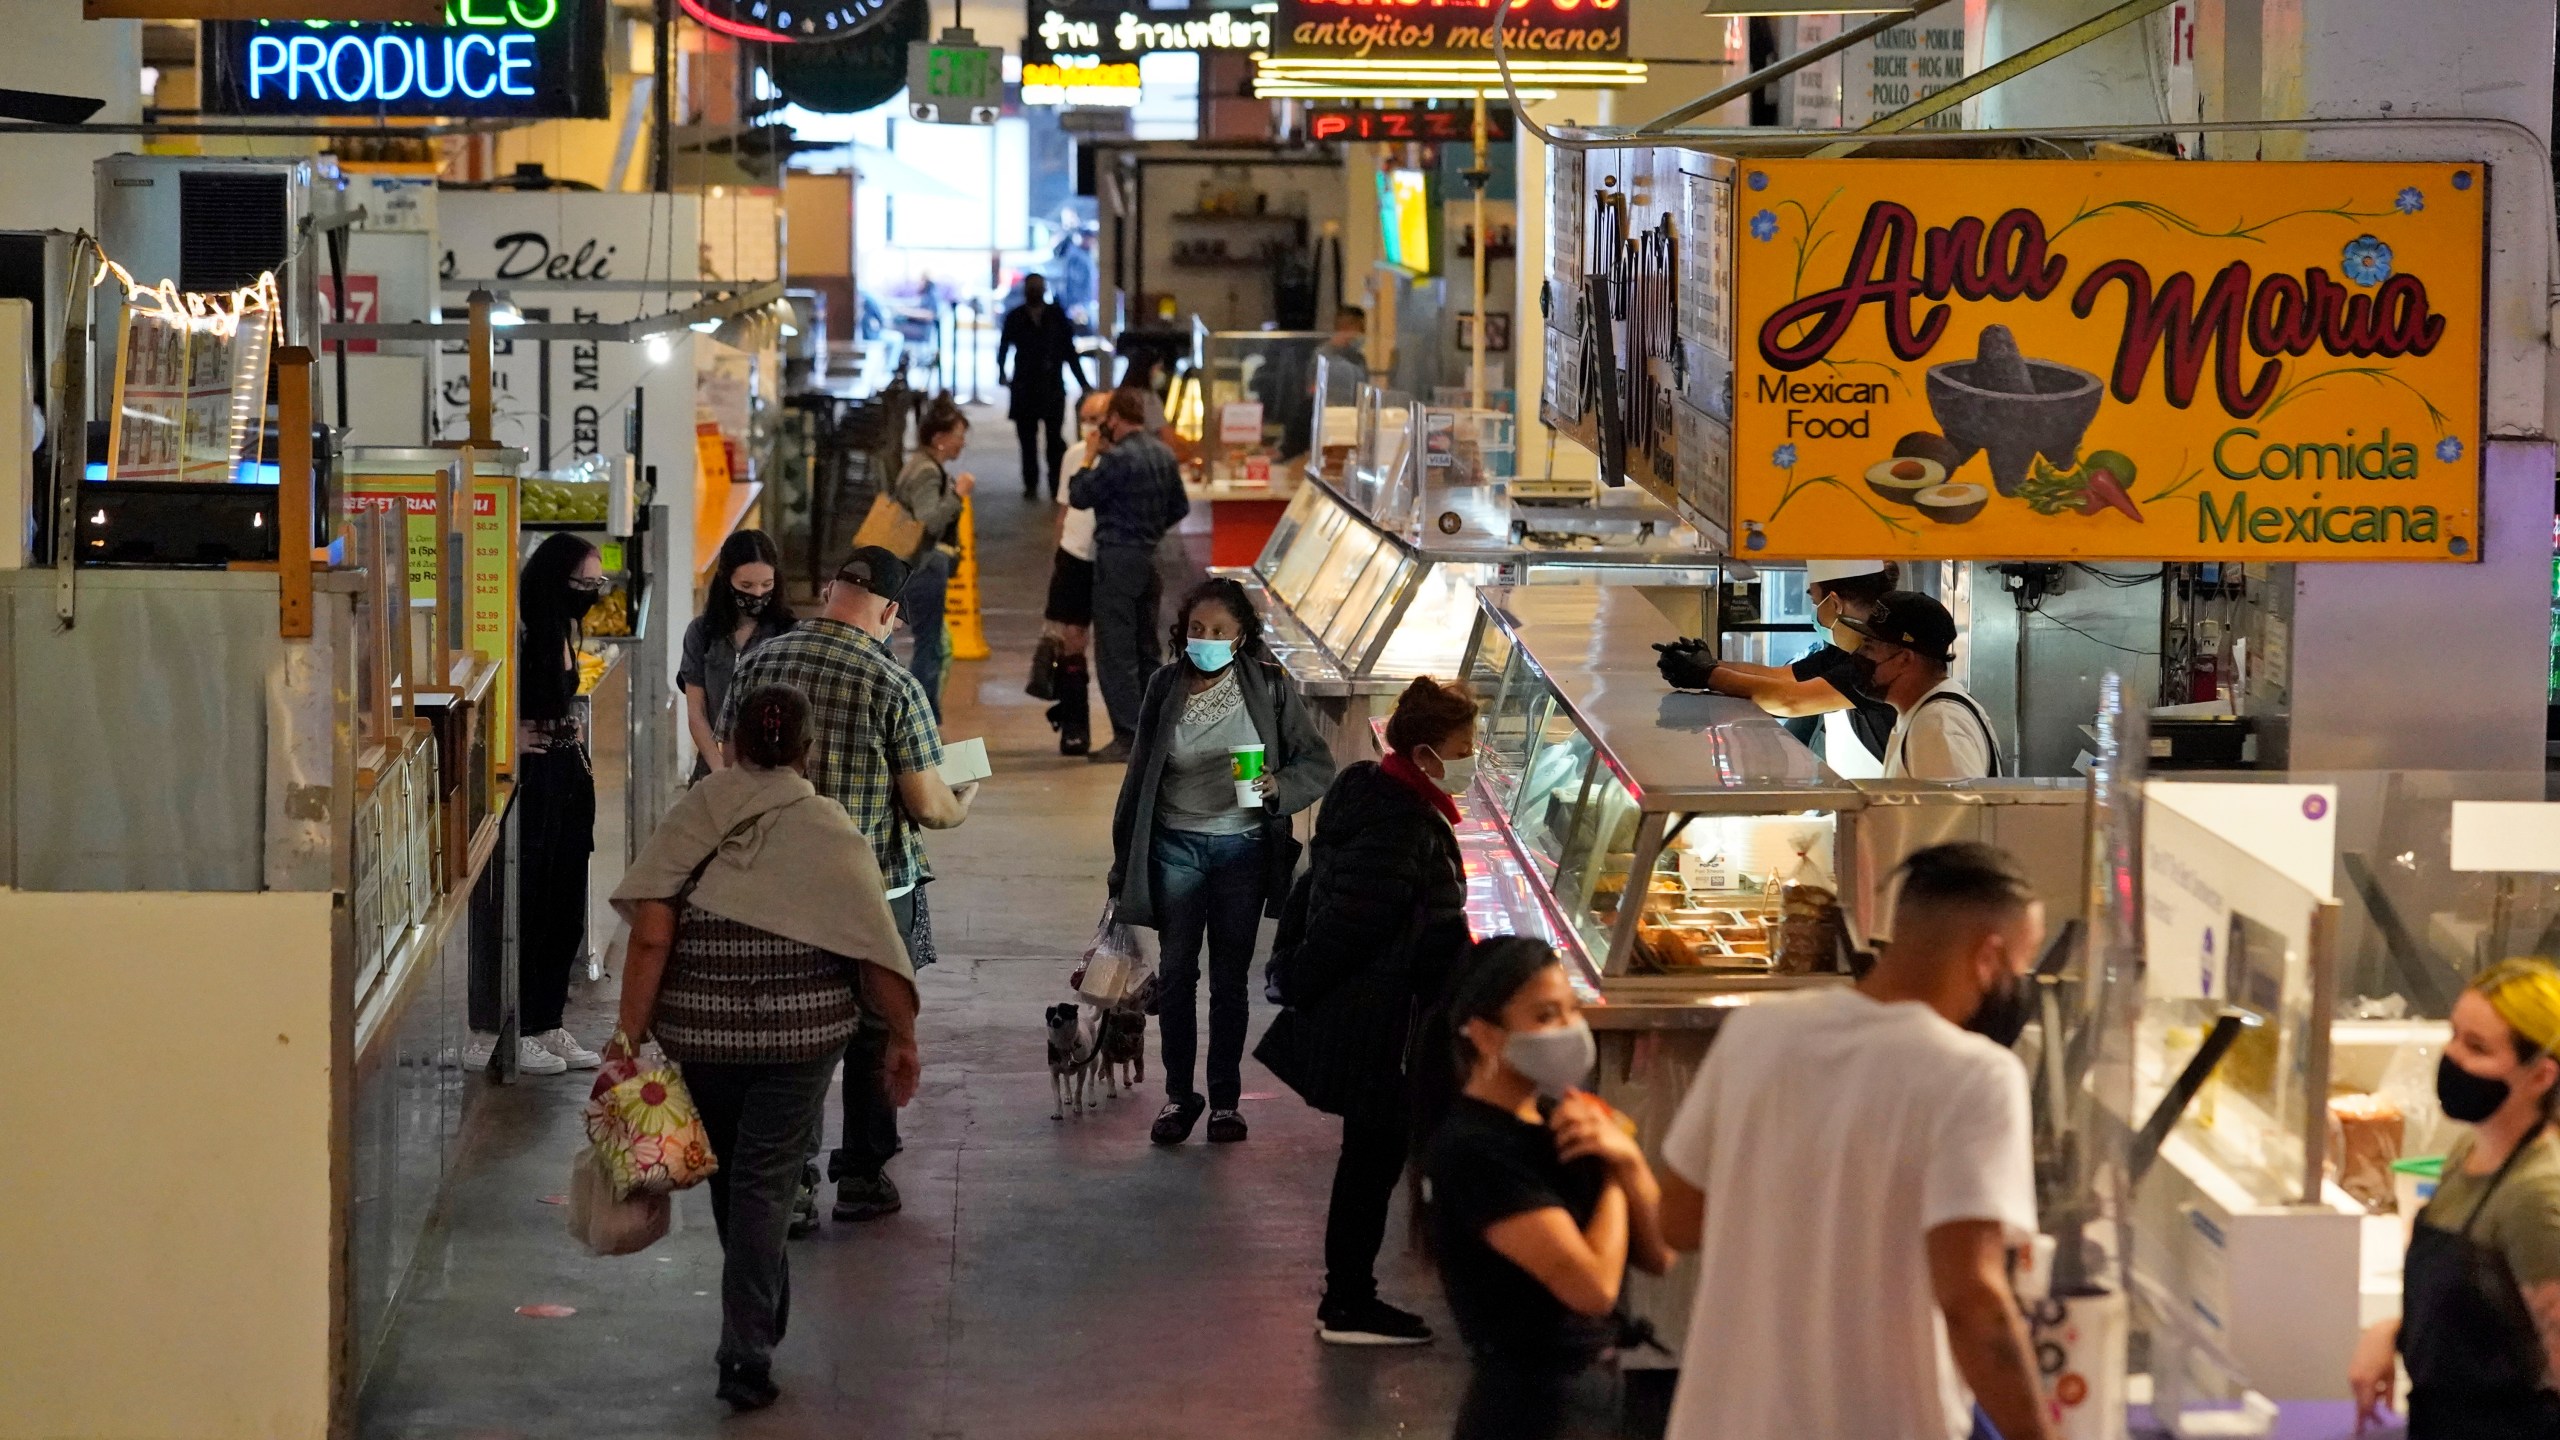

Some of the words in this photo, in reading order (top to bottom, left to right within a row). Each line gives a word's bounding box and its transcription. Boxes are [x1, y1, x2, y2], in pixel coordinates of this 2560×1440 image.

[1446, 19, 1621, 50] mexicanos
[250, 34, 536, 102] PRODUCE
[929, 48, 988, 98] EXIT
[1873, 57, 1907, 77] BUCHE
[1918, 57, 1942, 77] HOG
[1872, 84, 1909, 104] POLLO
[494, 231, 616, 281] Deli
[1759, 201, 2067, 371] Ana
[2071, 259, 2447, 418] Maria
[573, 306, 600, 392] MET
[1757, 374, 1890, 404] Mexican
[1786, 409, 1870, 439] Food
[2213, 427, 2419, 481] Comida
[2198, 490, 2440, 544] Mexicana
